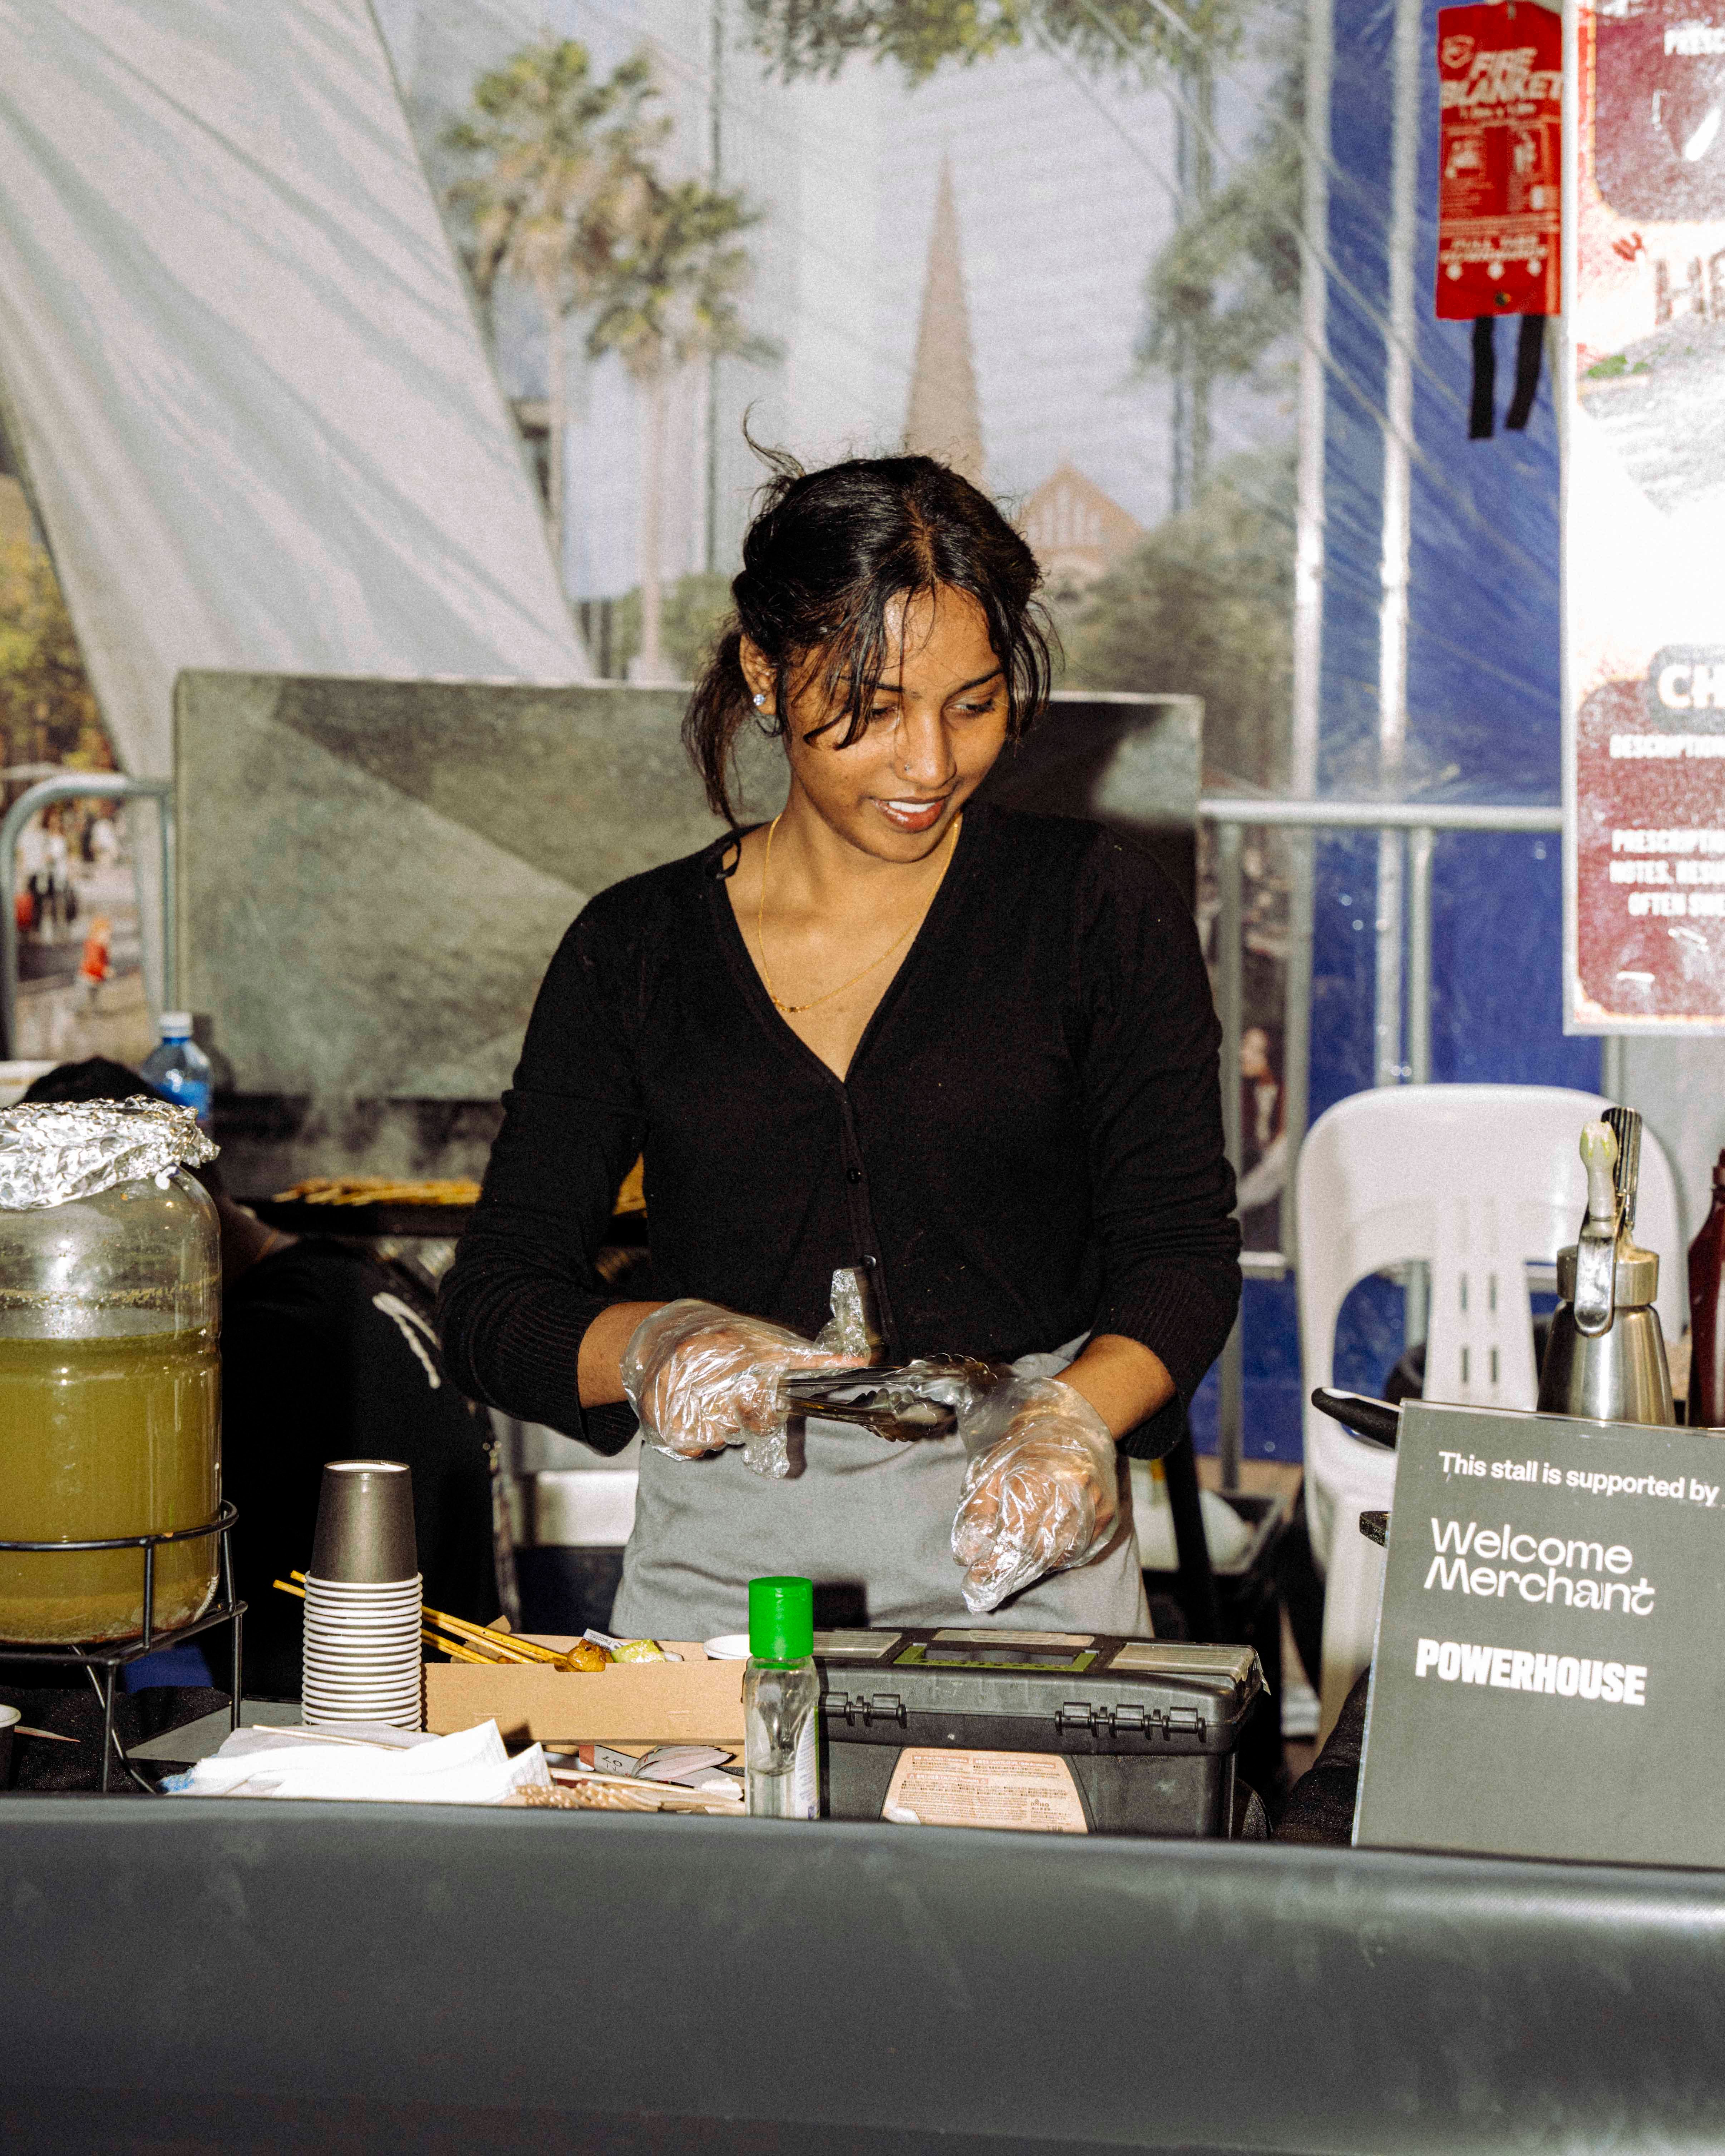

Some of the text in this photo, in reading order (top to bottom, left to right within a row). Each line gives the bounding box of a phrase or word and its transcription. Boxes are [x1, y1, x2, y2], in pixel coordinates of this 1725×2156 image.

[1440, 70, 1563, 109] BLANKET
[1469, 46, 1538, 78] FIRE
[1628, 892, 1686, 916] OFTEN
[1439, 1451, 1720, 1507] This stall is supported by
[1431, 1517, 1633, 1574] Welcome
[1424, 1555, 1656, 1616] Merchant
[1415, 1638, 1648, 1706] POWERHOUSE
